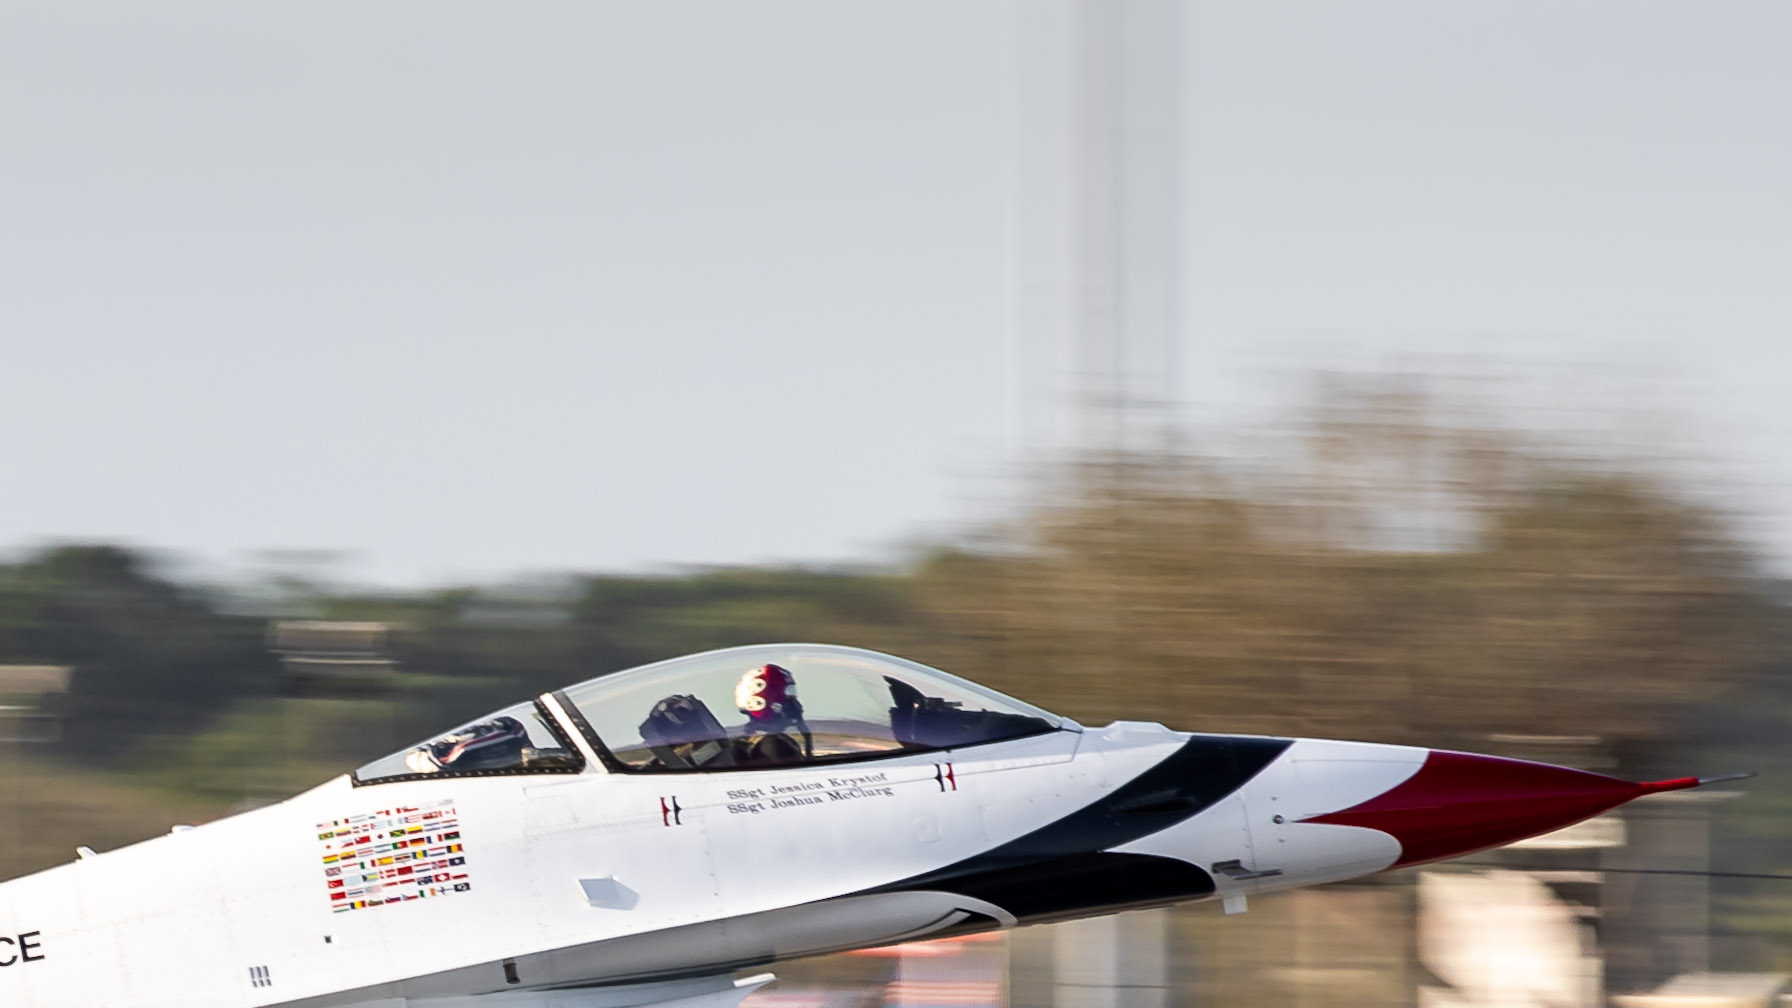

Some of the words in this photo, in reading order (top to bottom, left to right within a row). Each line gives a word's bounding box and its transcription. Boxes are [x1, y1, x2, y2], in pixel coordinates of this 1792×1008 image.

[726, 788, 765, 800] SSgt
[770, 781, 825, 795] Jessica
[726, 802, 765, 814] SSgt
[770, 796, 825, 809] Joshua
[827, 786, 895, 802] McClurg
